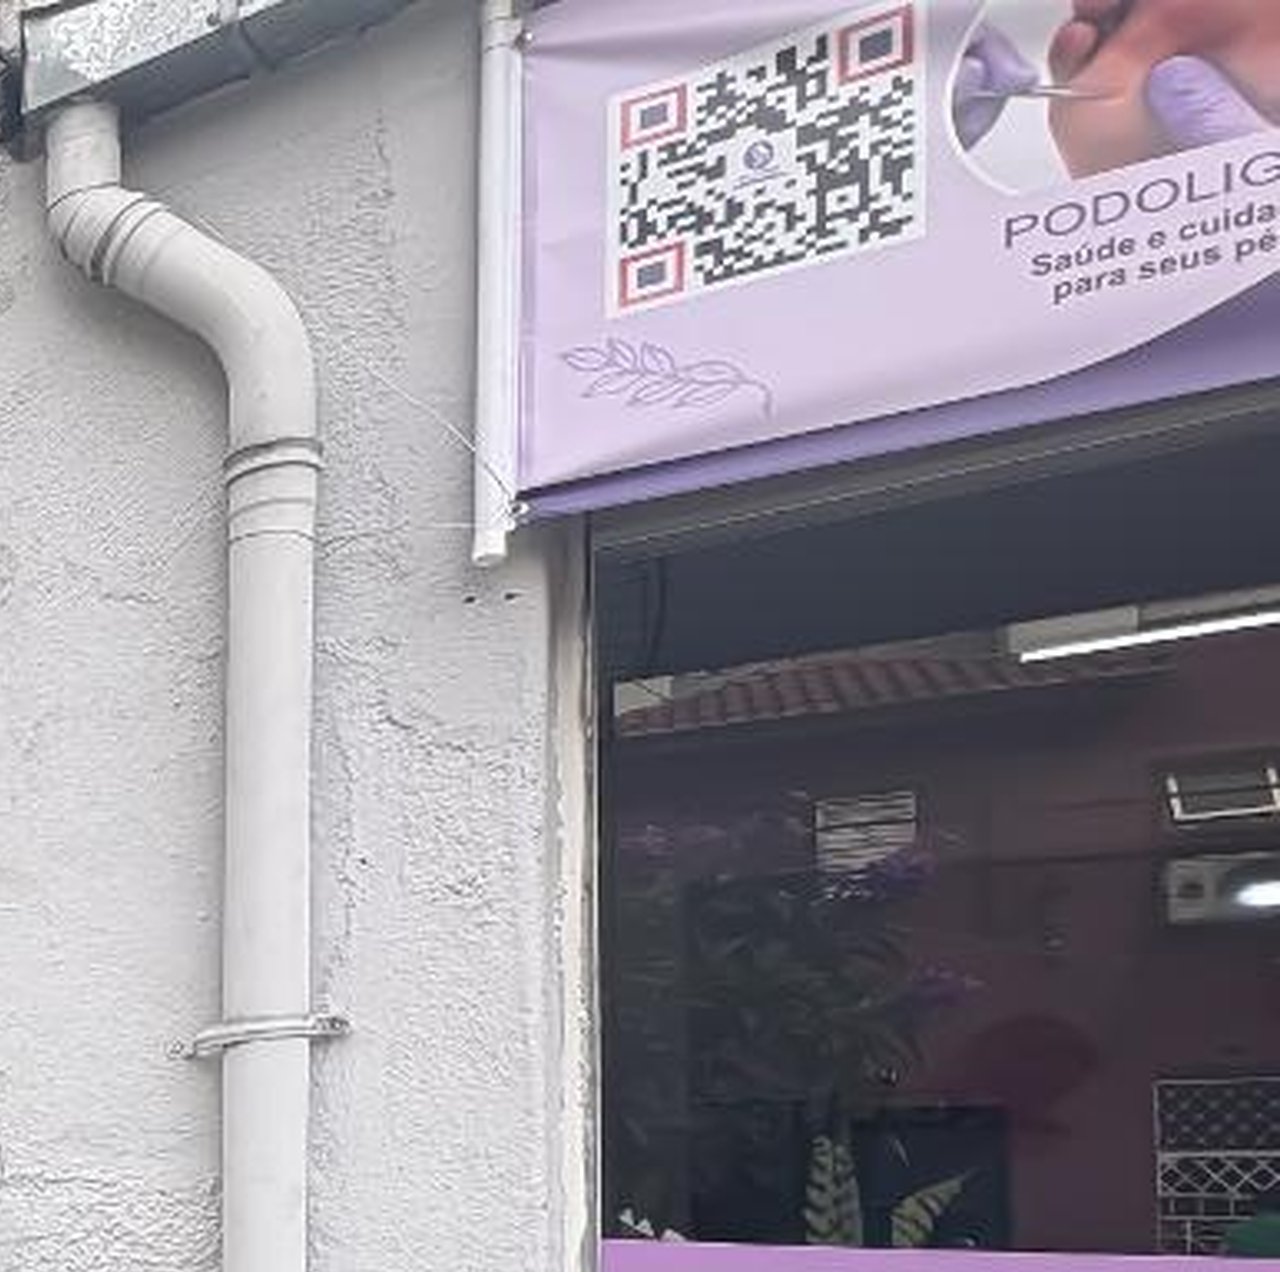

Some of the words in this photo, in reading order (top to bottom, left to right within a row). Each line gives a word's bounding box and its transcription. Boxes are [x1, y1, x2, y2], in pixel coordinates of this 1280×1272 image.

[1004, 152, 1280, 249] PODOLIG
[1031, 237, 1136, 276] Saúde
[1146, 231, 1167, 249] e
[1178, 203, 1277, 240] cuida
[1052, 268, 1127, 304] para
[1139, 245, 1222, 279] seus
